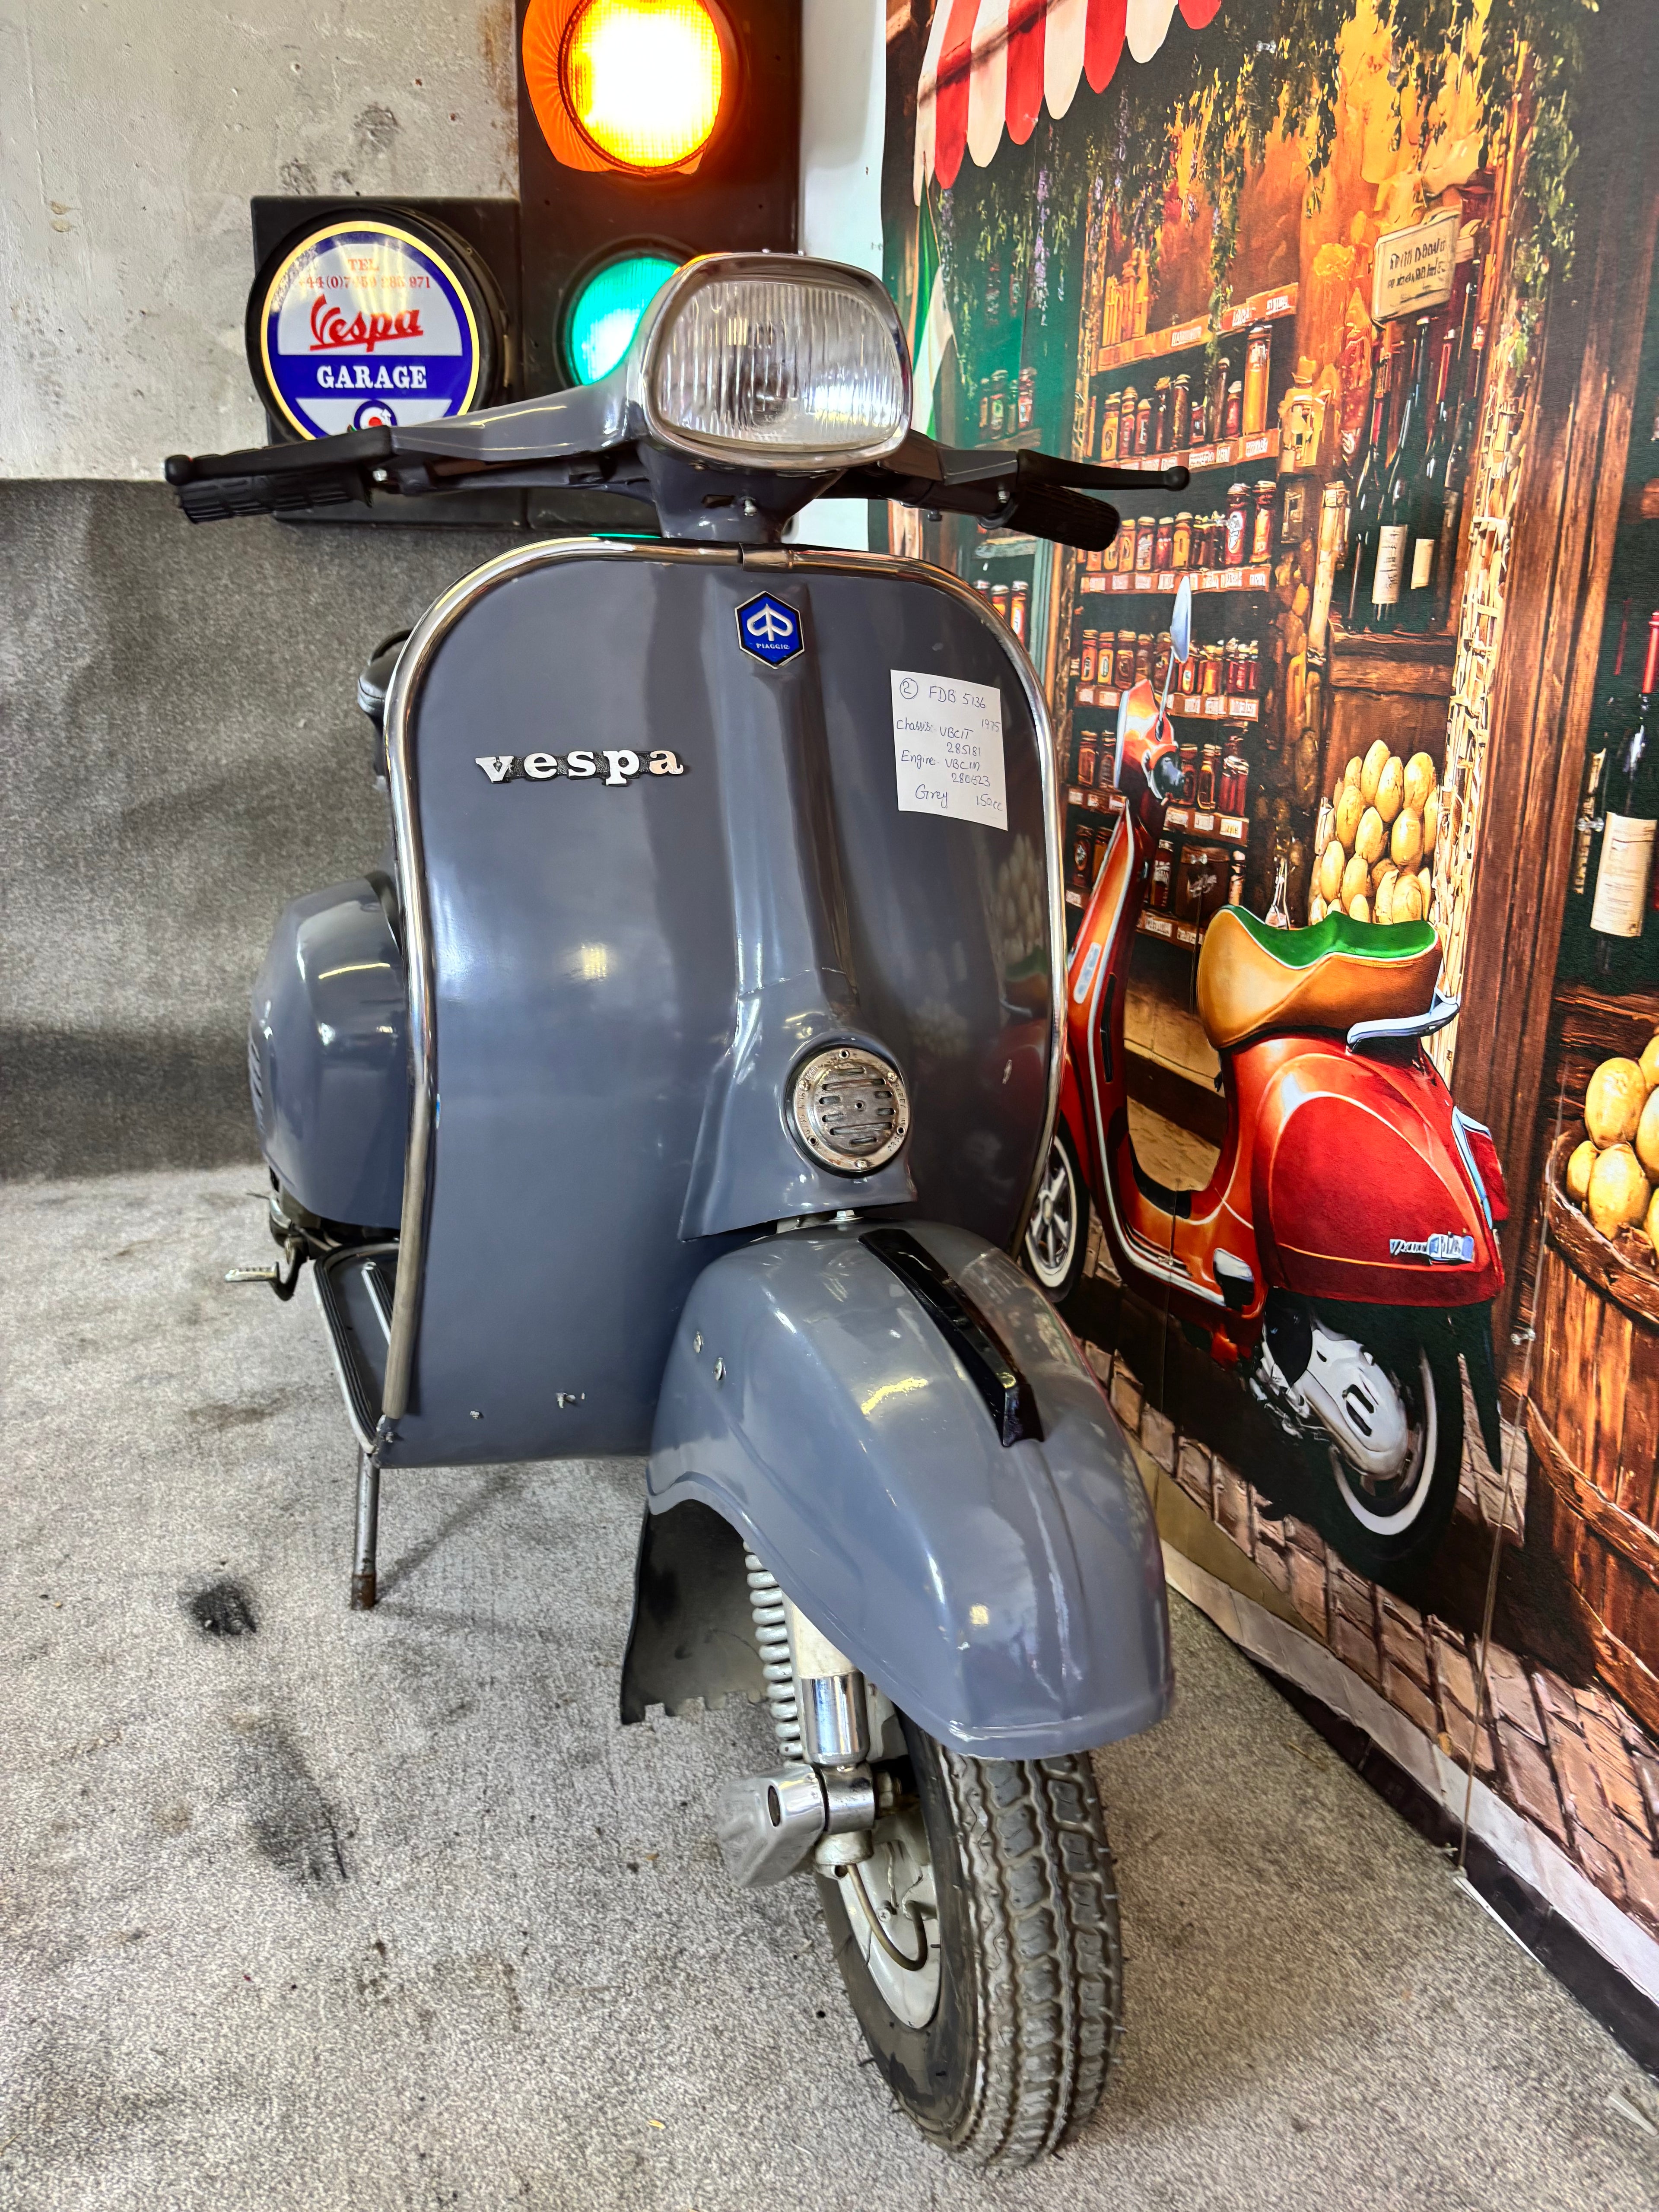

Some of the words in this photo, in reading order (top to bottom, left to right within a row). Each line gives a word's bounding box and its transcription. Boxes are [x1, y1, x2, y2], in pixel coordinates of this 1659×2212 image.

[348, 258, 380, 271] TEL
[409, 276, 431, 289] 971
[309, 294, 424, 353] Vespa
[316, 365, 427, 389] GARAGE
[929, 685, 956, 703] FDB
[962, 693, 986, 709] 5136
[982, 718, 1001, 732] 1975
[946, 742, 981, 756] 285181
[475, 749, 685, 786] vespa
[915, 784, 948, 809] Grey
